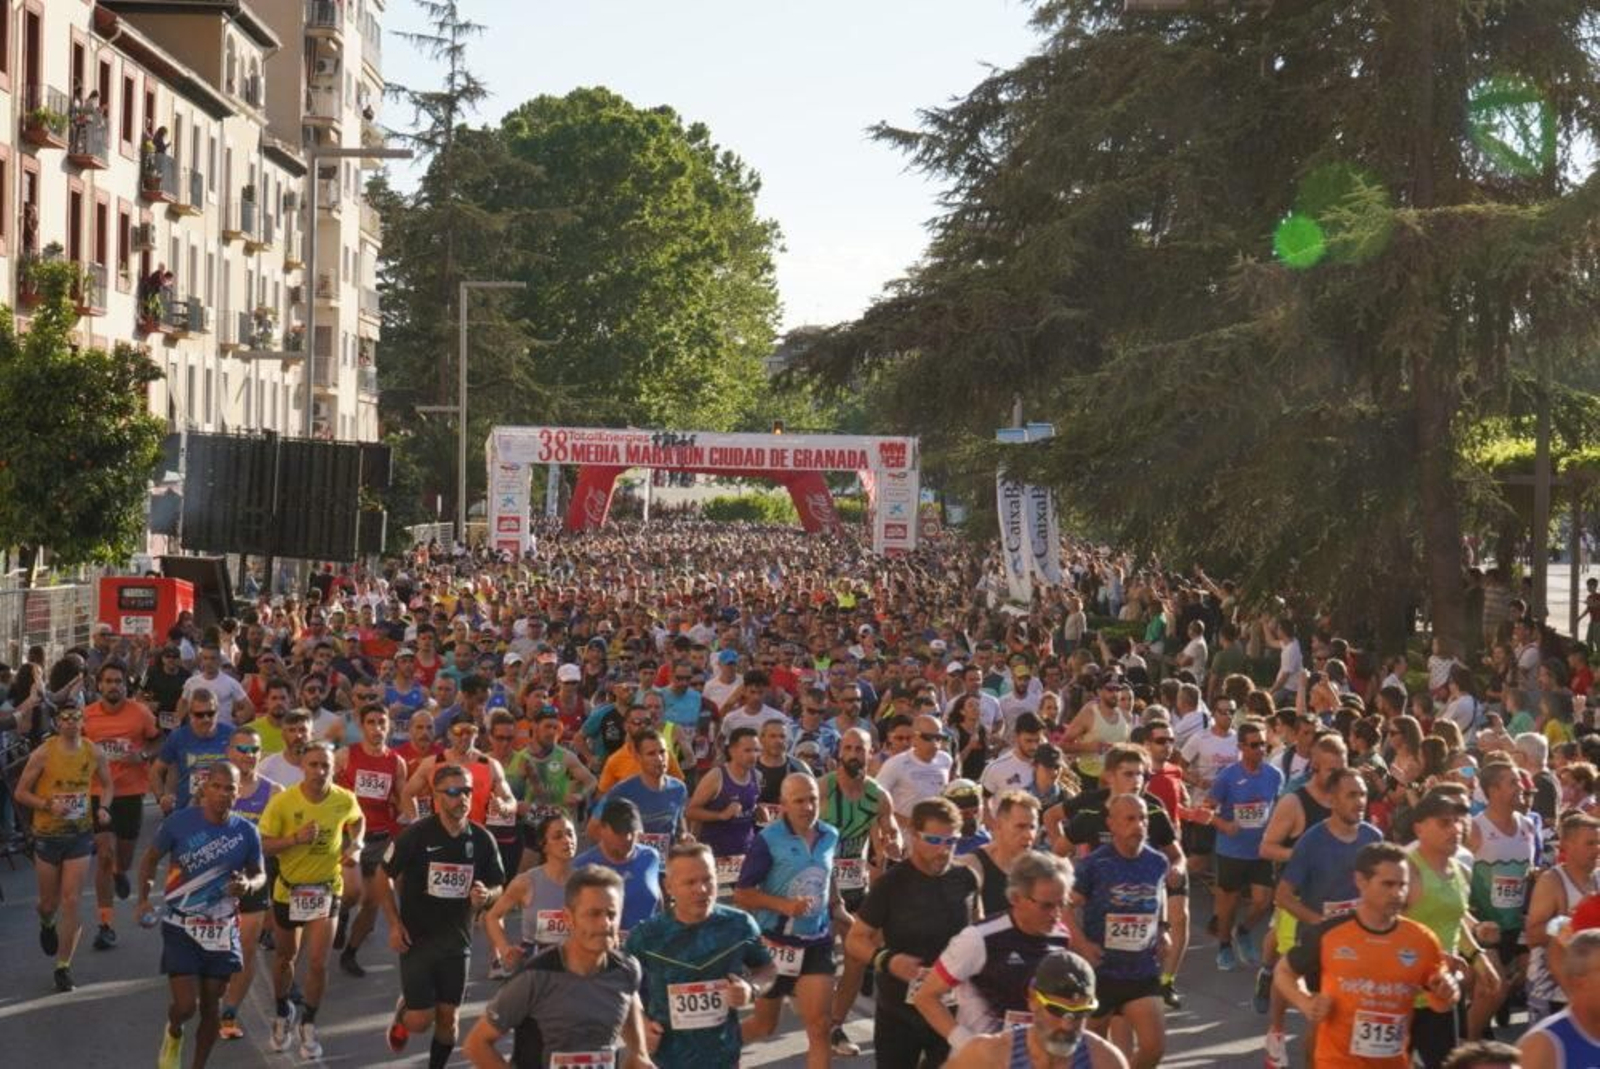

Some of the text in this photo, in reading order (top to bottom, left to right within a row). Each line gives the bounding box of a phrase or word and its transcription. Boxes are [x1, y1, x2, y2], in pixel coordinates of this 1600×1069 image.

[569, 431, 650, 443] TotalEnergies
[538, 429, 568, 462] 38
[571, 443, 869, 469] MEDIA MARATON CIUDAD DE GRANADA
[360, 775, 386, 789] 3934
[433, 872, 466, 887] 2489
[293, 896, 325, 910] 1658
[191, 925, 223, 940] 1787
[1111, 923, 1147, 938] 2475
[675, 991, 722, 1013] 3036
